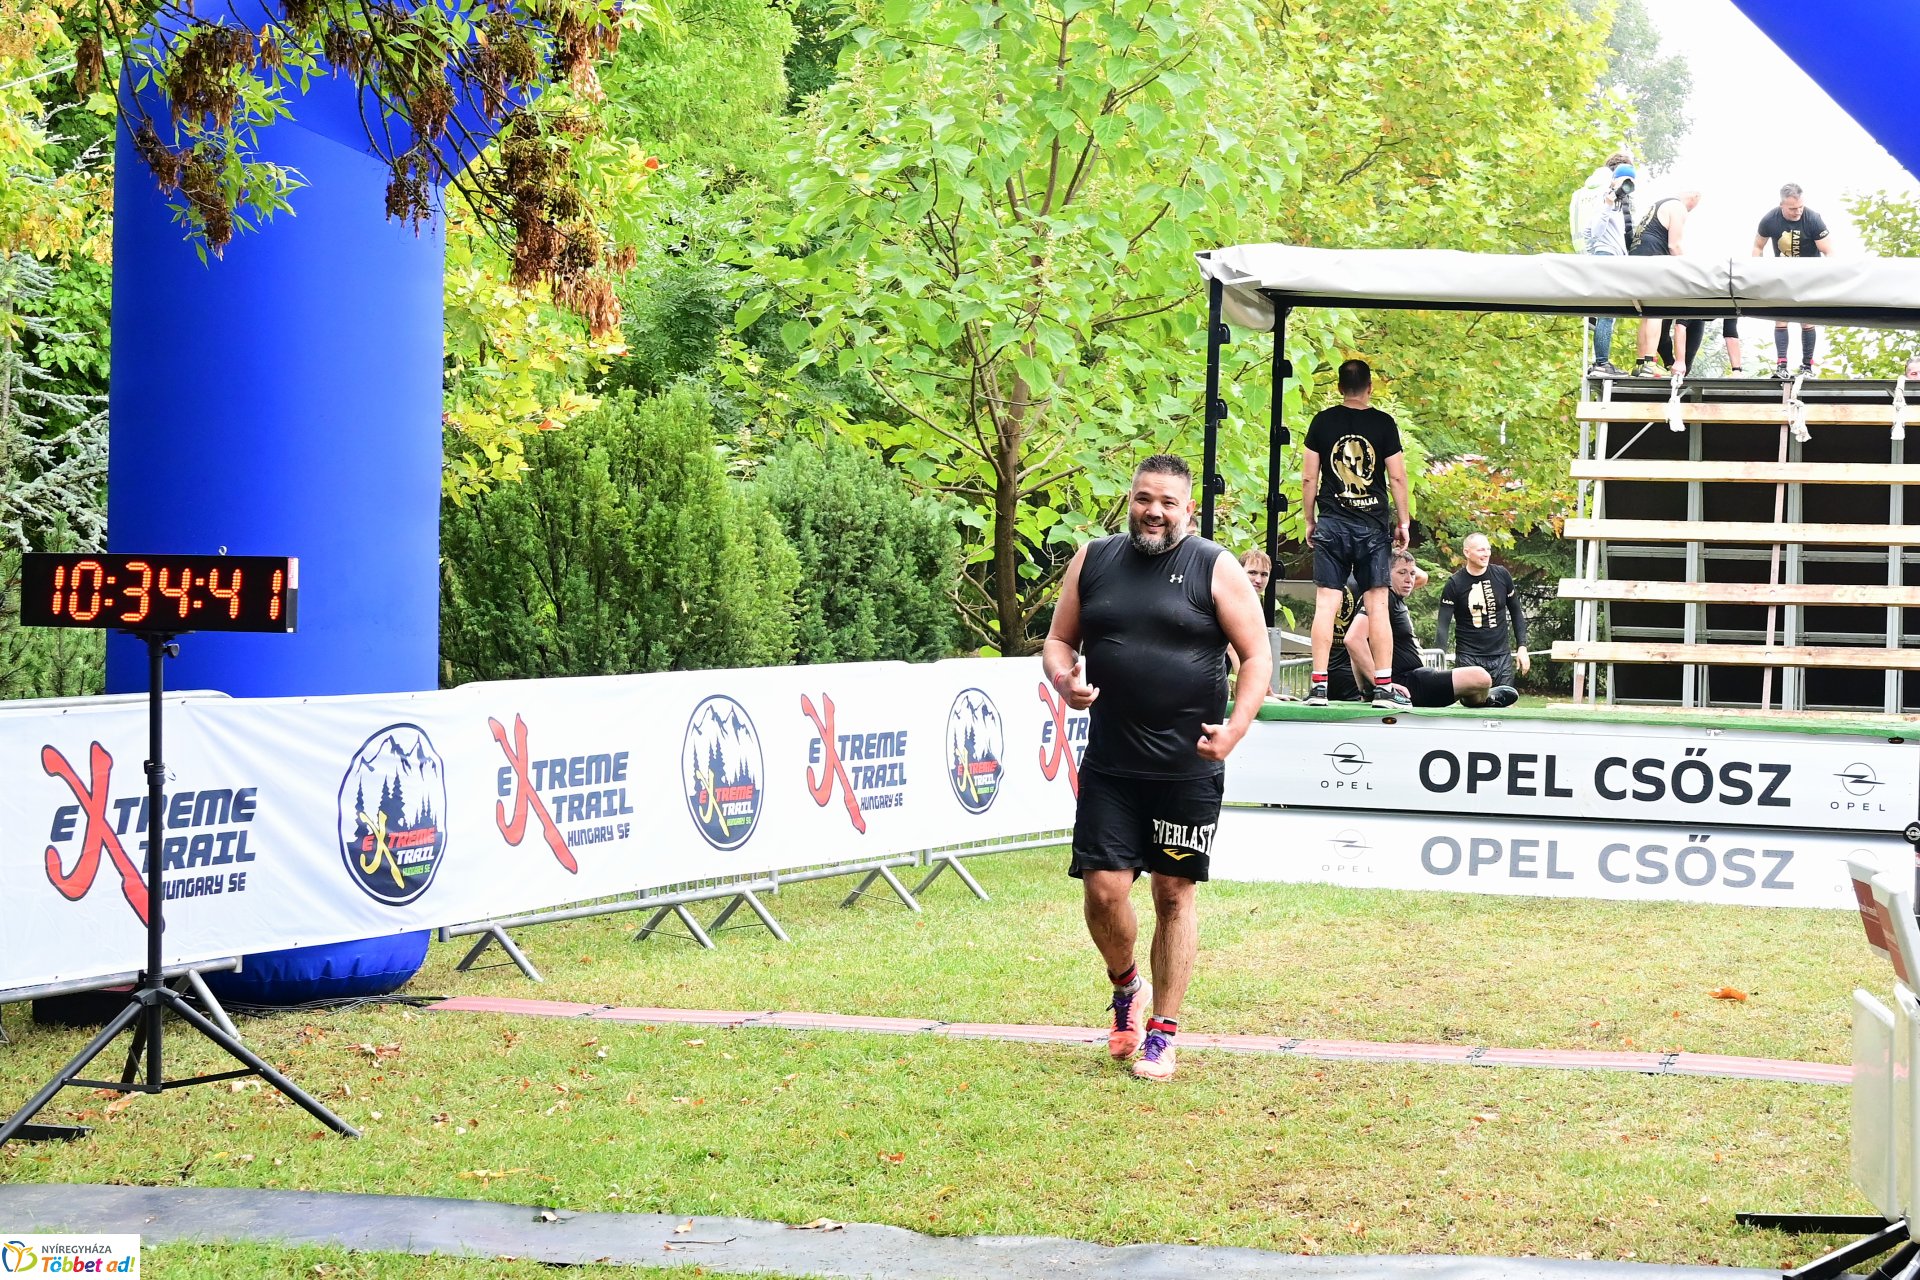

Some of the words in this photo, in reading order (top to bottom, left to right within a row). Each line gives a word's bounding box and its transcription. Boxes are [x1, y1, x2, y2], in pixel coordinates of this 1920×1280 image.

[52, 561, 282, 622] 10:34:41
[1482, 579, 1498, 629] FARKASFALKA
[800, 692, 908, 835] EXTREME
[851, 762, 907, 791] TRAIL
[1419, 749, 1573, 798] OPEL
[1594, 747, 1792, 807] CSŐSZ
[487, 712, 629, 875] EXTREME
[1320, 780, 1374, 790] OPEL
[551, 787, 634, 824] TRAIL
[722, 800, 754, 817] TRAIL
[1830, 801, 1886, 812] OPEL
[567, 825, 614, 848] HUNGARY
[617, 822, 631, 840] SE
[396, 845, 435, 866] TRAIL
[1420, 835, 1575, 880] OPEL
[1598, 834, 1794, 890] CSŐSZ
[227, 871, 247, 893] SE
